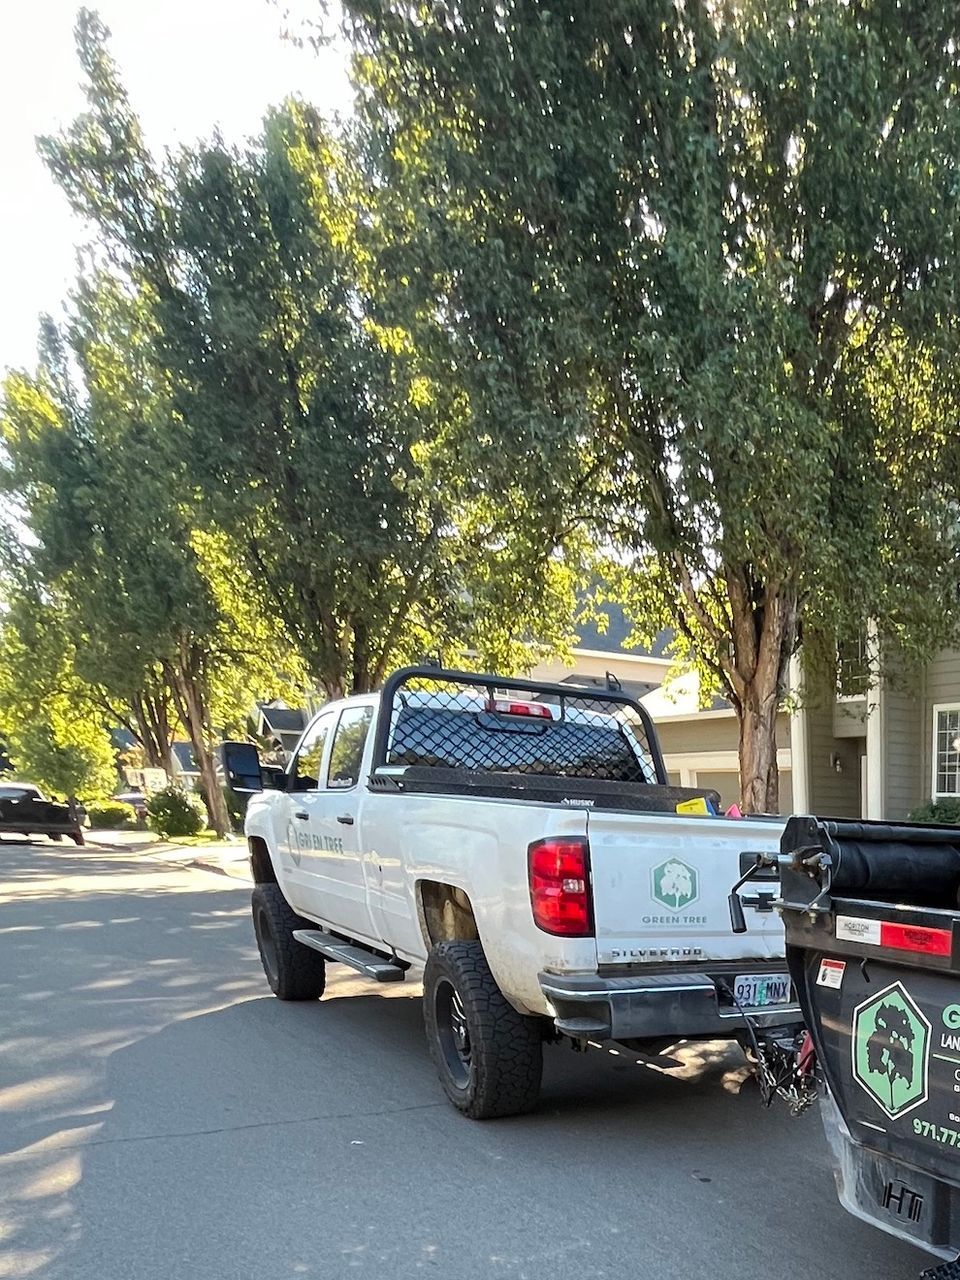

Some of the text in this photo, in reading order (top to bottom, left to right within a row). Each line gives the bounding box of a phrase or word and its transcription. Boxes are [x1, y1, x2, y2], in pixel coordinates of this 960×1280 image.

[641, 916, 707, 924] GREEN TREE
[737, 982, 788, 1000] 931 MNX
